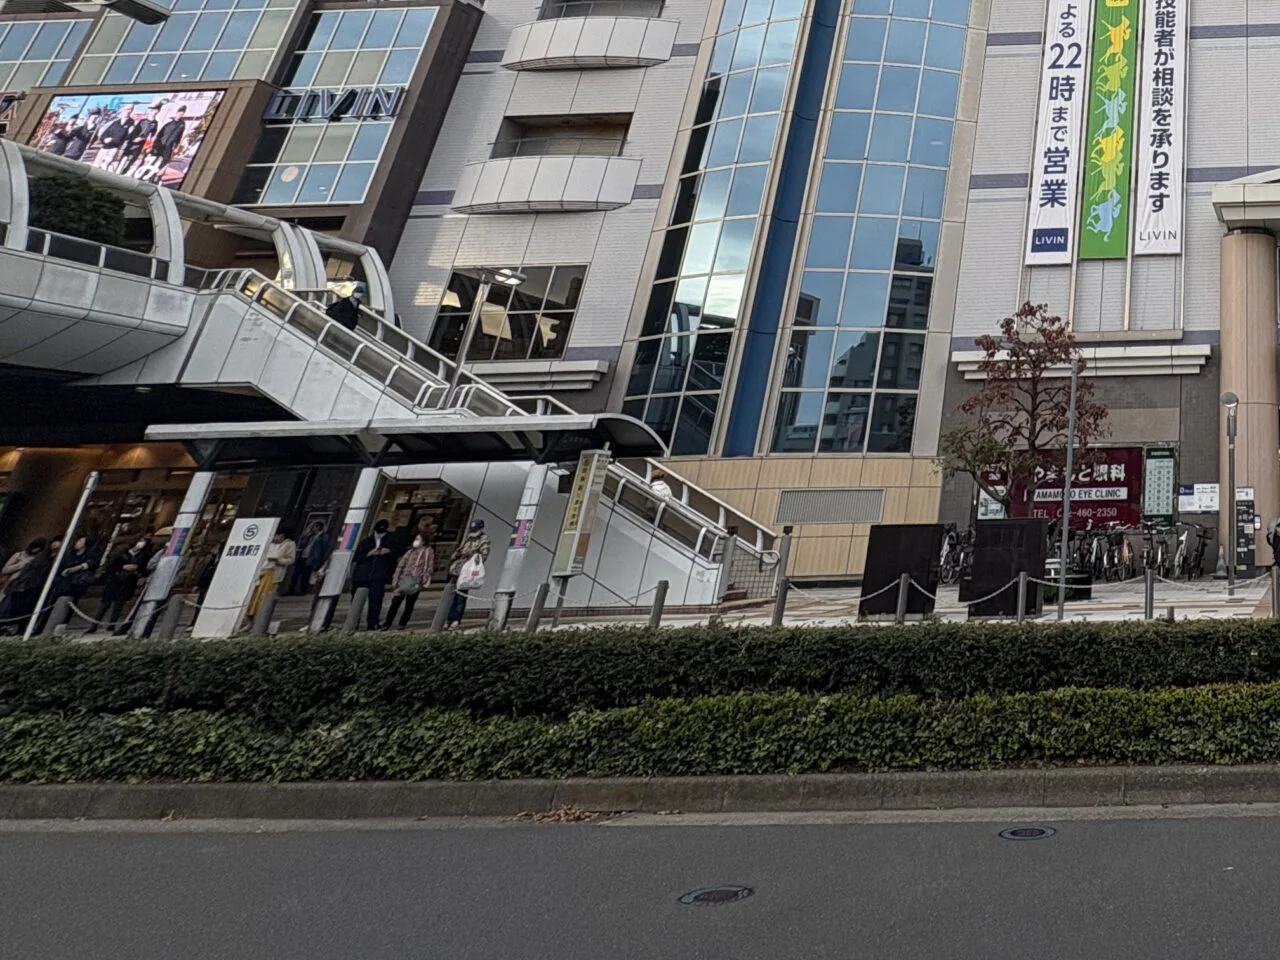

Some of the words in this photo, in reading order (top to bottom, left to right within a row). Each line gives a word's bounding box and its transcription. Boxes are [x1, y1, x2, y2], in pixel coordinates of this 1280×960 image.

[263, 87, 402, 119] LIVIN
[1035, 236, 1065, 244] LIVIN
[1139, 230, 1177, 241] LIVIN
[1078, 489, 1093, 498] EYE
[1095, 488, 1121, 498] CLINIC
[1033, 509, 1049, 519] TEL
